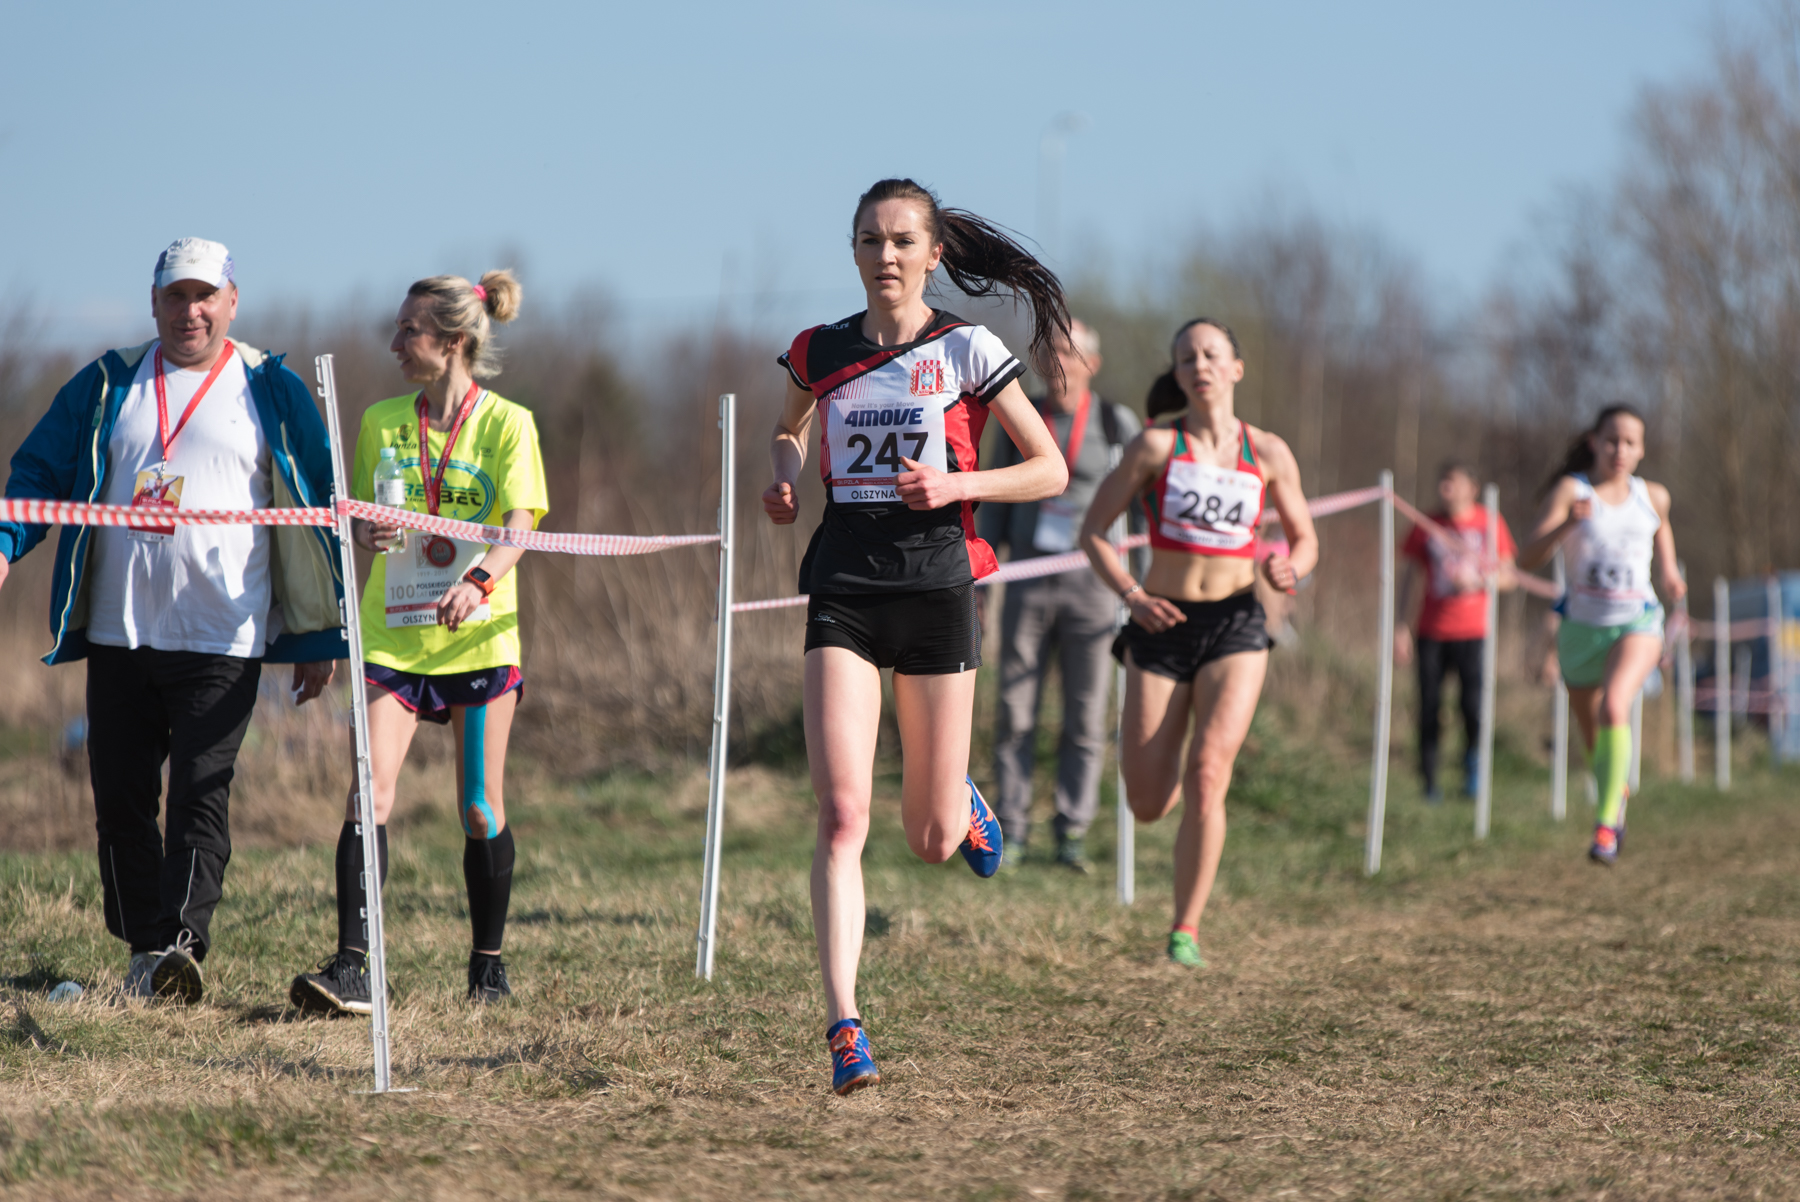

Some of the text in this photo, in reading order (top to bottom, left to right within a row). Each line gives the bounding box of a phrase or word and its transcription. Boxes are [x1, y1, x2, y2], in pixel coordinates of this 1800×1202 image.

[879, 402, 895, 410] your
[844, 407, 924, 428] 4MOVE
[846, 431, 929, 474] 247
[851, 490, 896, 500] OLSZYNA
[1178, 491, 1244, 525] 284
[390, 584, 415, 601] 100
[416, 581, 452, 590] POLSKIEGO
[402, 613, 436, 625] OLSZYN
